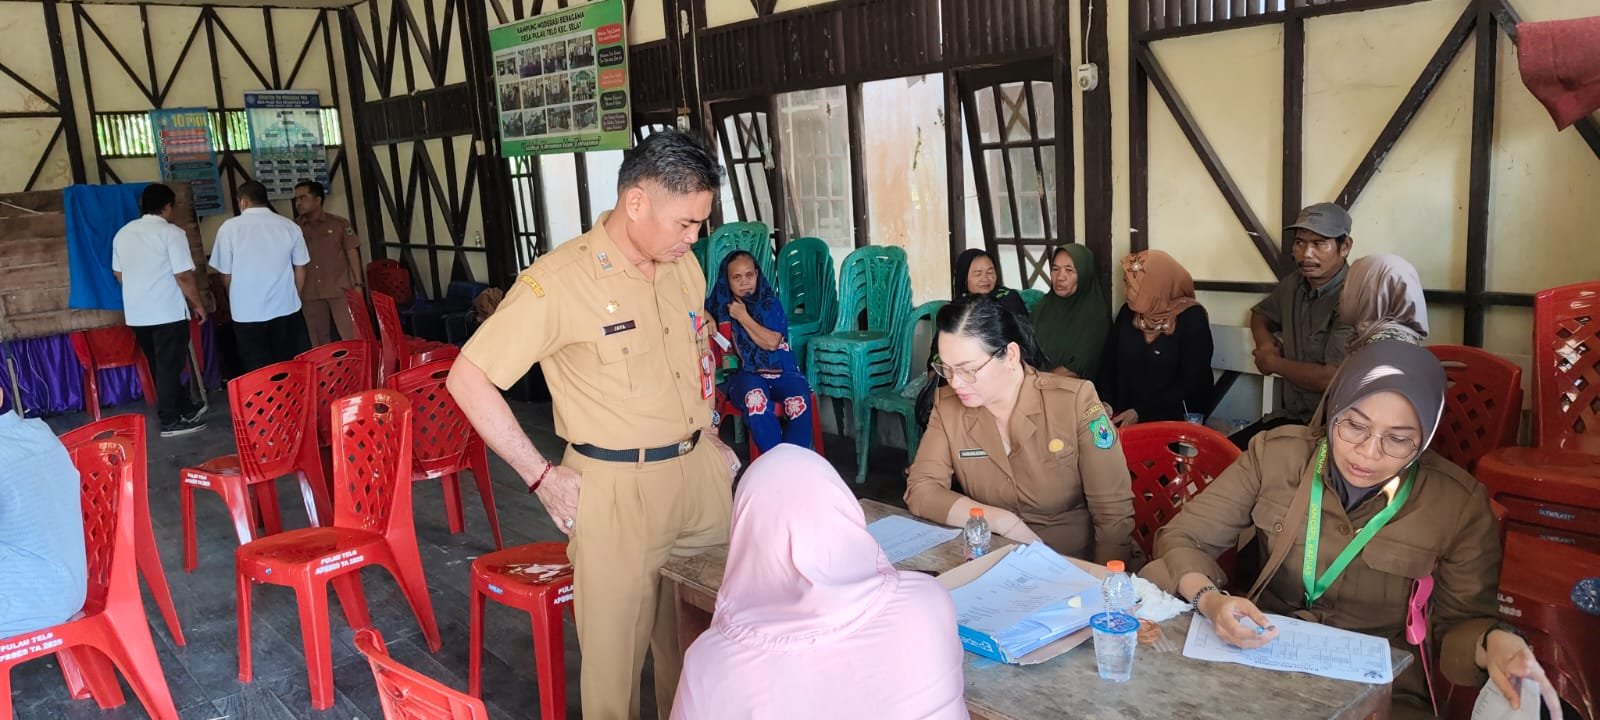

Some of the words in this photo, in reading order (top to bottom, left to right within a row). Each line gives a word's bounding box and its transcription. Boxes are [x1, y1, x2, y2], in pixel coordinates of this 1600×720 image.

[517, 23, 537, 33] KAMPUNG
[521, 34, 531, 42] DESA
[532, 30, 546, 39] PULAU
[547, 28, 557, 36] TELO
[569, 21, 581, 31] SELAT
[321, 554, 341, 565] PULAU
[341, 550, 357, 559] TELO
[340, 560, 350, 568] TA
[0, 639, 30, 652] PULAU
[31, 632, 54, 644] TELO
[29, 645, 42, 653] TA
